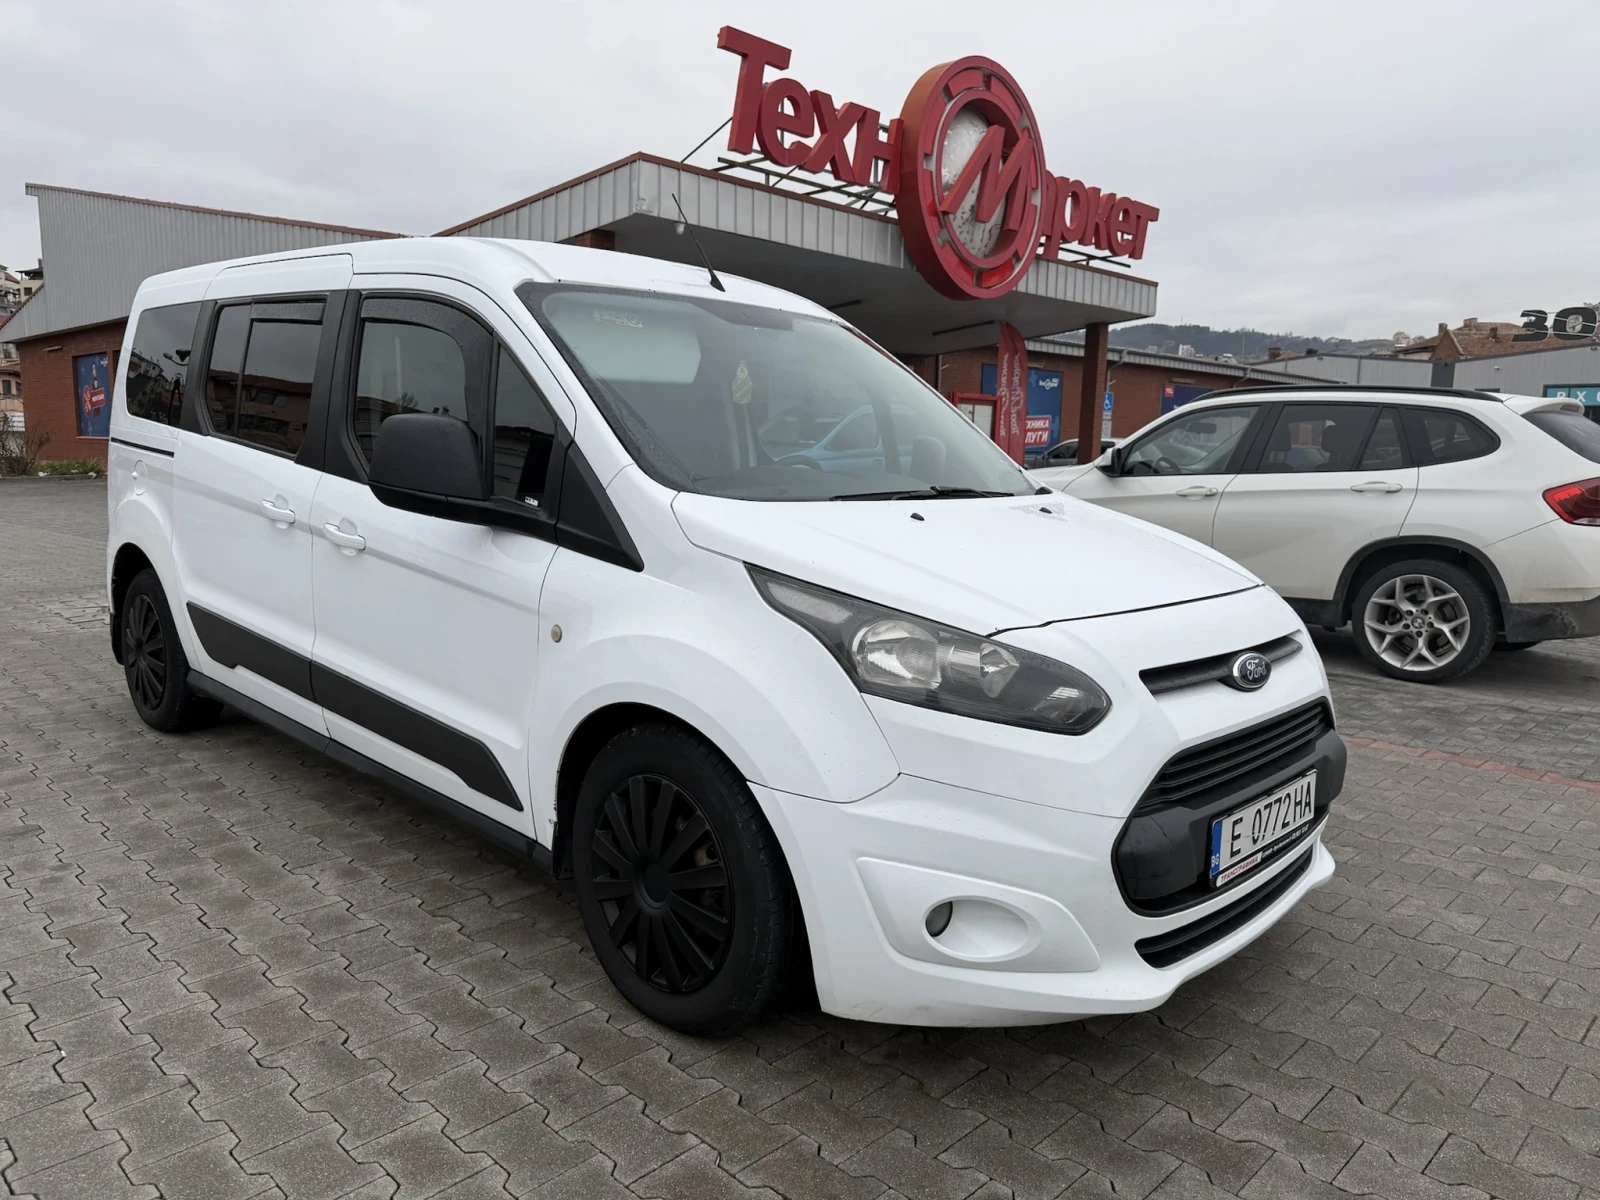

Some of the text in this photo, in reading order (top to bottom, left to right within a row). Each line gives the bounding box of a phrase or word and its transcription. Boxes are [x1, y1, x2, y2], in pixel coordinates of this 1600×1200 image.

[1025, 420, 1049, 429] ХНИКА
[1025, 430, 1049, 443] ЛУГИ
[1246, 658, 1267, 680] Ford
[1230, 817, 1243, 858] E
[1211, 854, 1220, 867] BG
